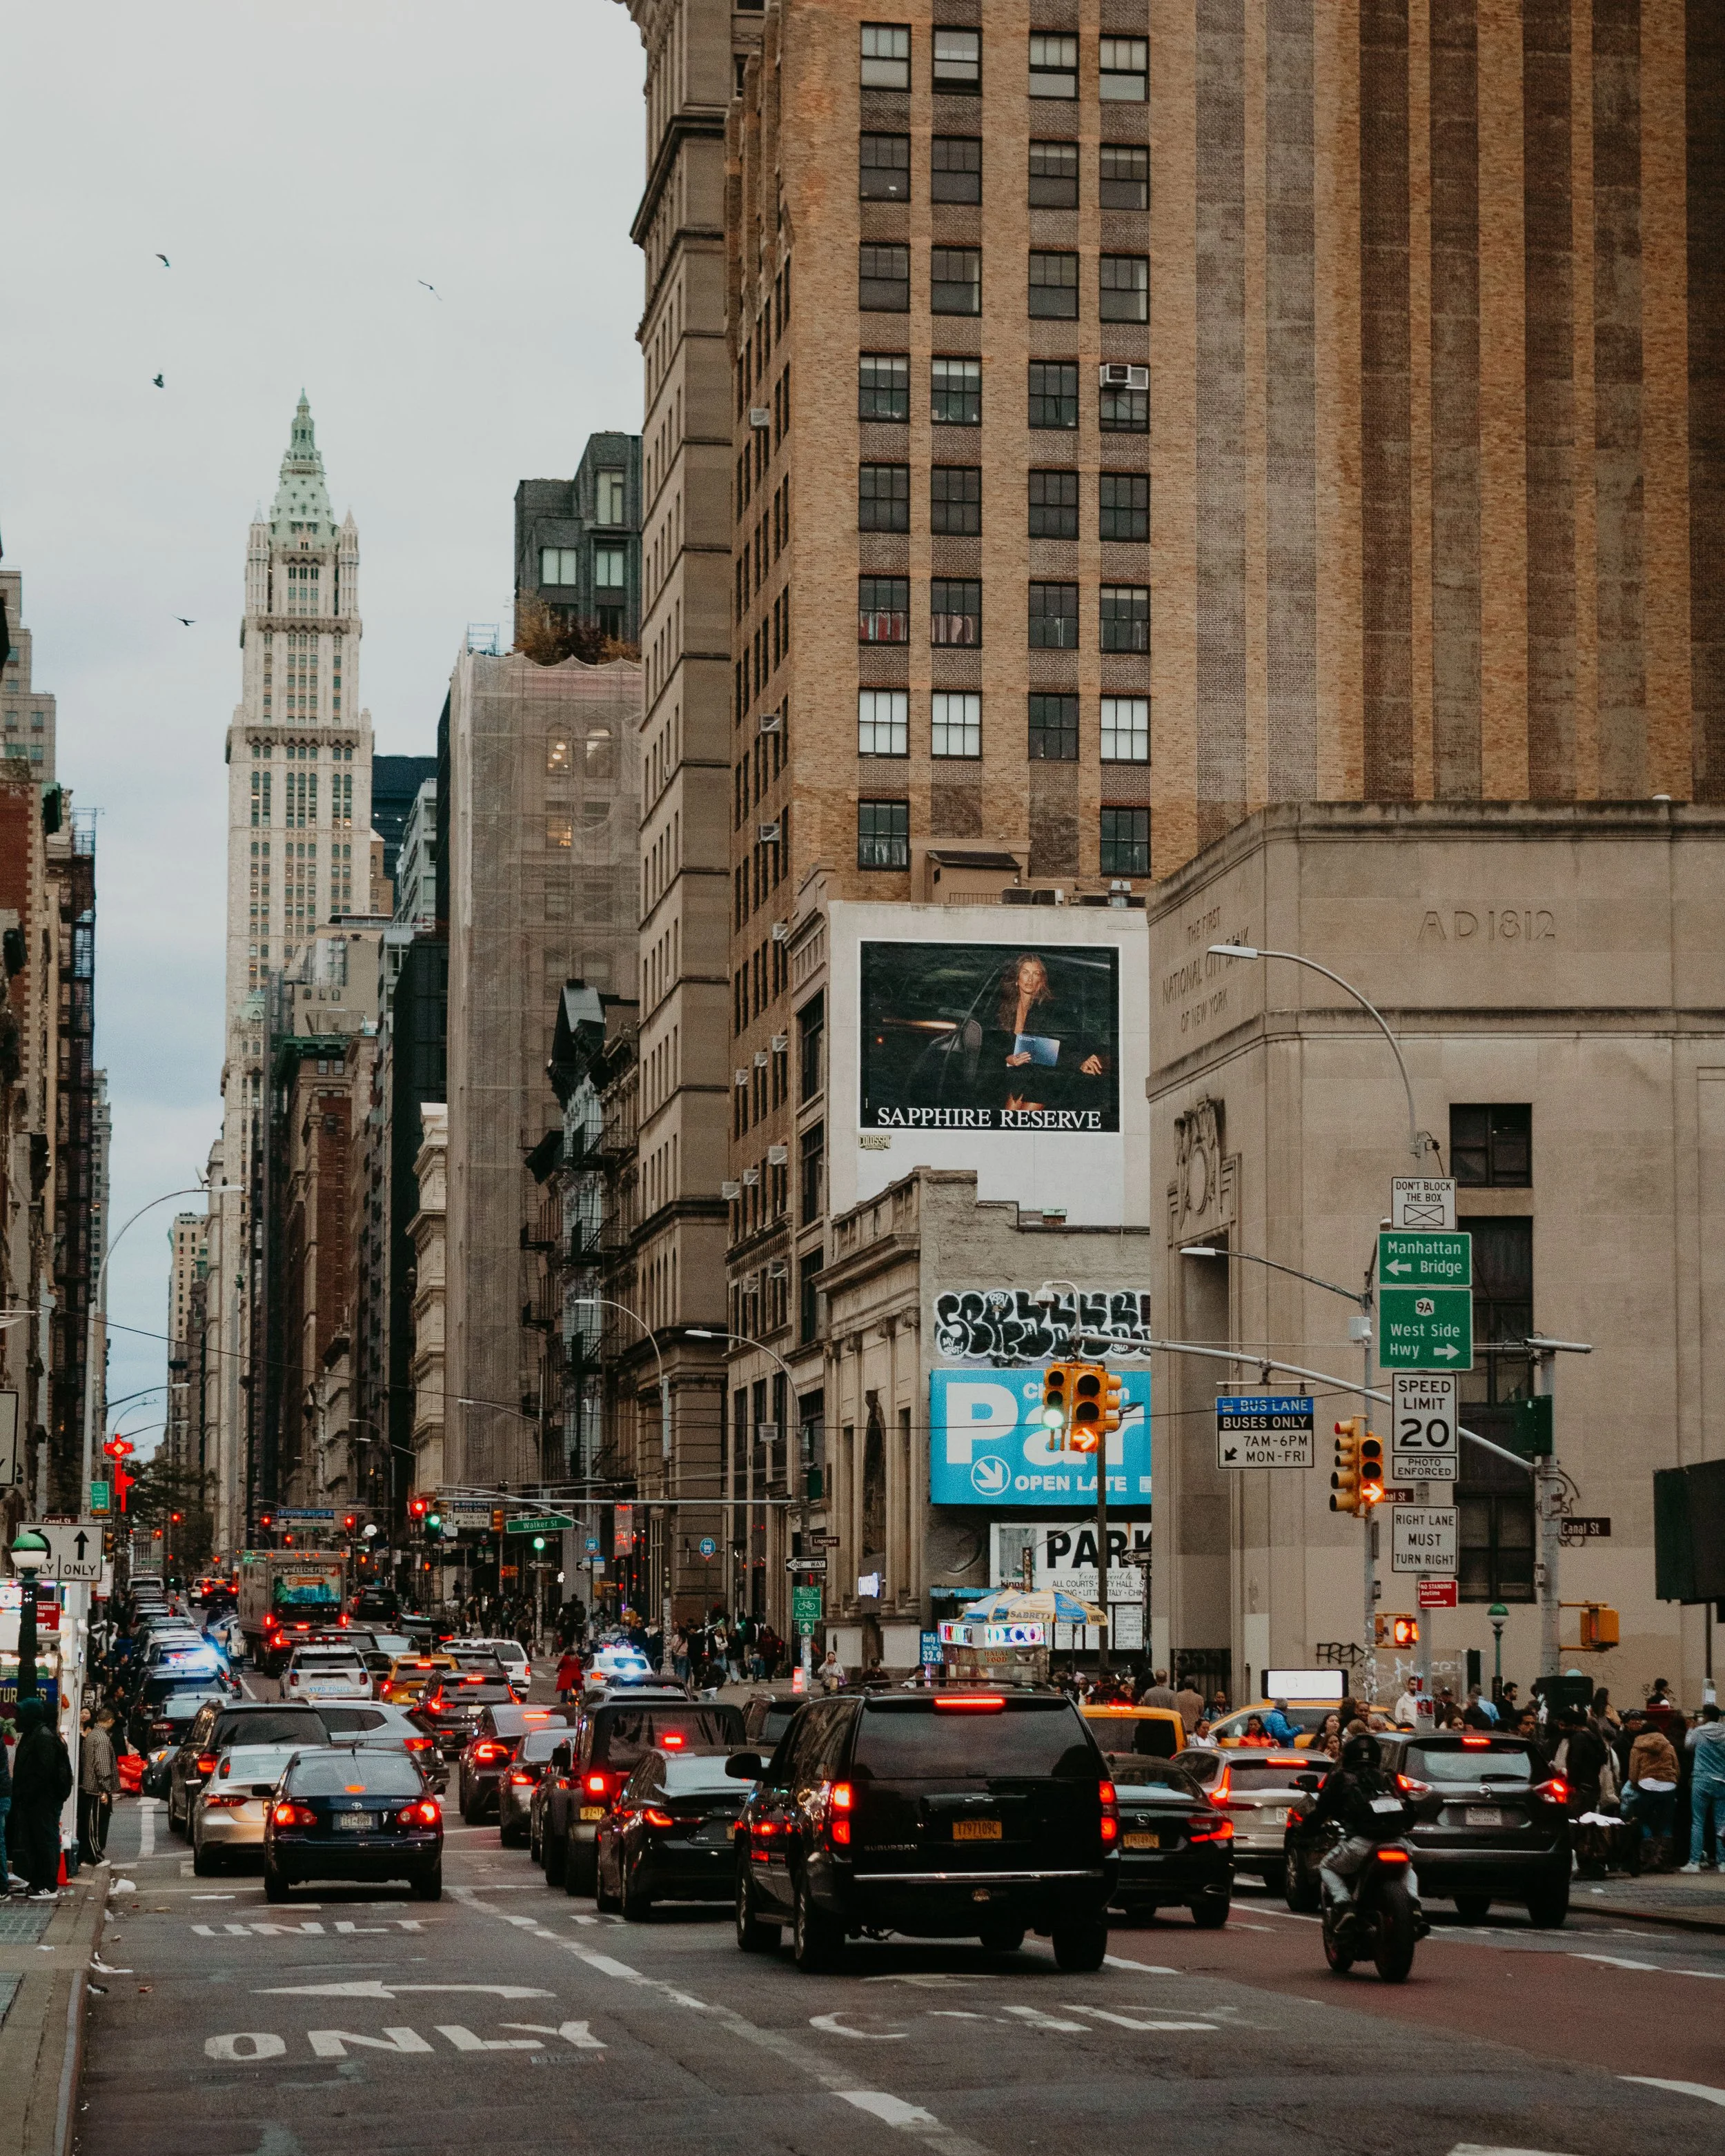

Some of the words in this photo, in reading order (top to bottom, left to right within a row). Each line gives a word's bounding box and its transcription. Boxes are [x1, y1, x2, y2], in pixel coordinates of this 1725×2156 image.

[1488, 910, 1555, 940] 1812
[1163, 958, 1202, 1009] NATIONAL
[877, 1107, 992, 1127] SAPPHIRE
[1000, 1109, 1101, 1129] RESERVE
[1396, 1181, 1420, 1190] DON'T
[1423, 1182, 1451, 1191] BLOCK
[1406, 1193, 1421, 1201] THE
[1426, 1194, 1441, 1202] BOX
[1388, 1241, 1461, 1254] Manhattan
[1420, 1260, 1462, 1276] Bridge
[1417, 1301, 1432, 1313] 9A
[1390, 1323, 1425, 1336] West
[1431, 1323, 1461, 1337] Side
[1390, 1343, 1419, 1359] Hwy
[1399, 1380, 1450, 1393] SPEED
[1241, 1400, 1267, 1412] BUS
[1272, 1399, 1308, 1411] LANE
[1403, 1397, 1445, 1410] LIMIT
[1223, 1416, 1267, 1429] BUSES
[1272, 1416, 1308, 1428] ONLY
[1399, 1418, 1450, 1447] 20
[1408, 1458, 1441, 1467] PHOTO
[1398, 1467, 1451, 1476] ENFORCED
[1014, 1475, 1070, 1491] OPEN
[1398, 1491, 1406, 1501] St
[523, 1521, 548, 1529] Walker
[1396, 1514, 1425, 1525] RIGHT
[1429, 1515, 1454, 1525] LANE
[1562, 1521, 1587, 1534] Canal
[1590, 1522, 1599, 1534] St
[1408, 1533, 1441, 1546] MUST
[1395, 1553, 1421, 1564] TURN
[1425, 1554, 1454, 1565] RIGHT
[64, 1564, 96, 1576] ONLY
[1010, 1612, 1051, 1620] SABRETT
[863, 1843, 918, 1852] SUBURBAN
[205, 2020, 608, 2060] ONLY
